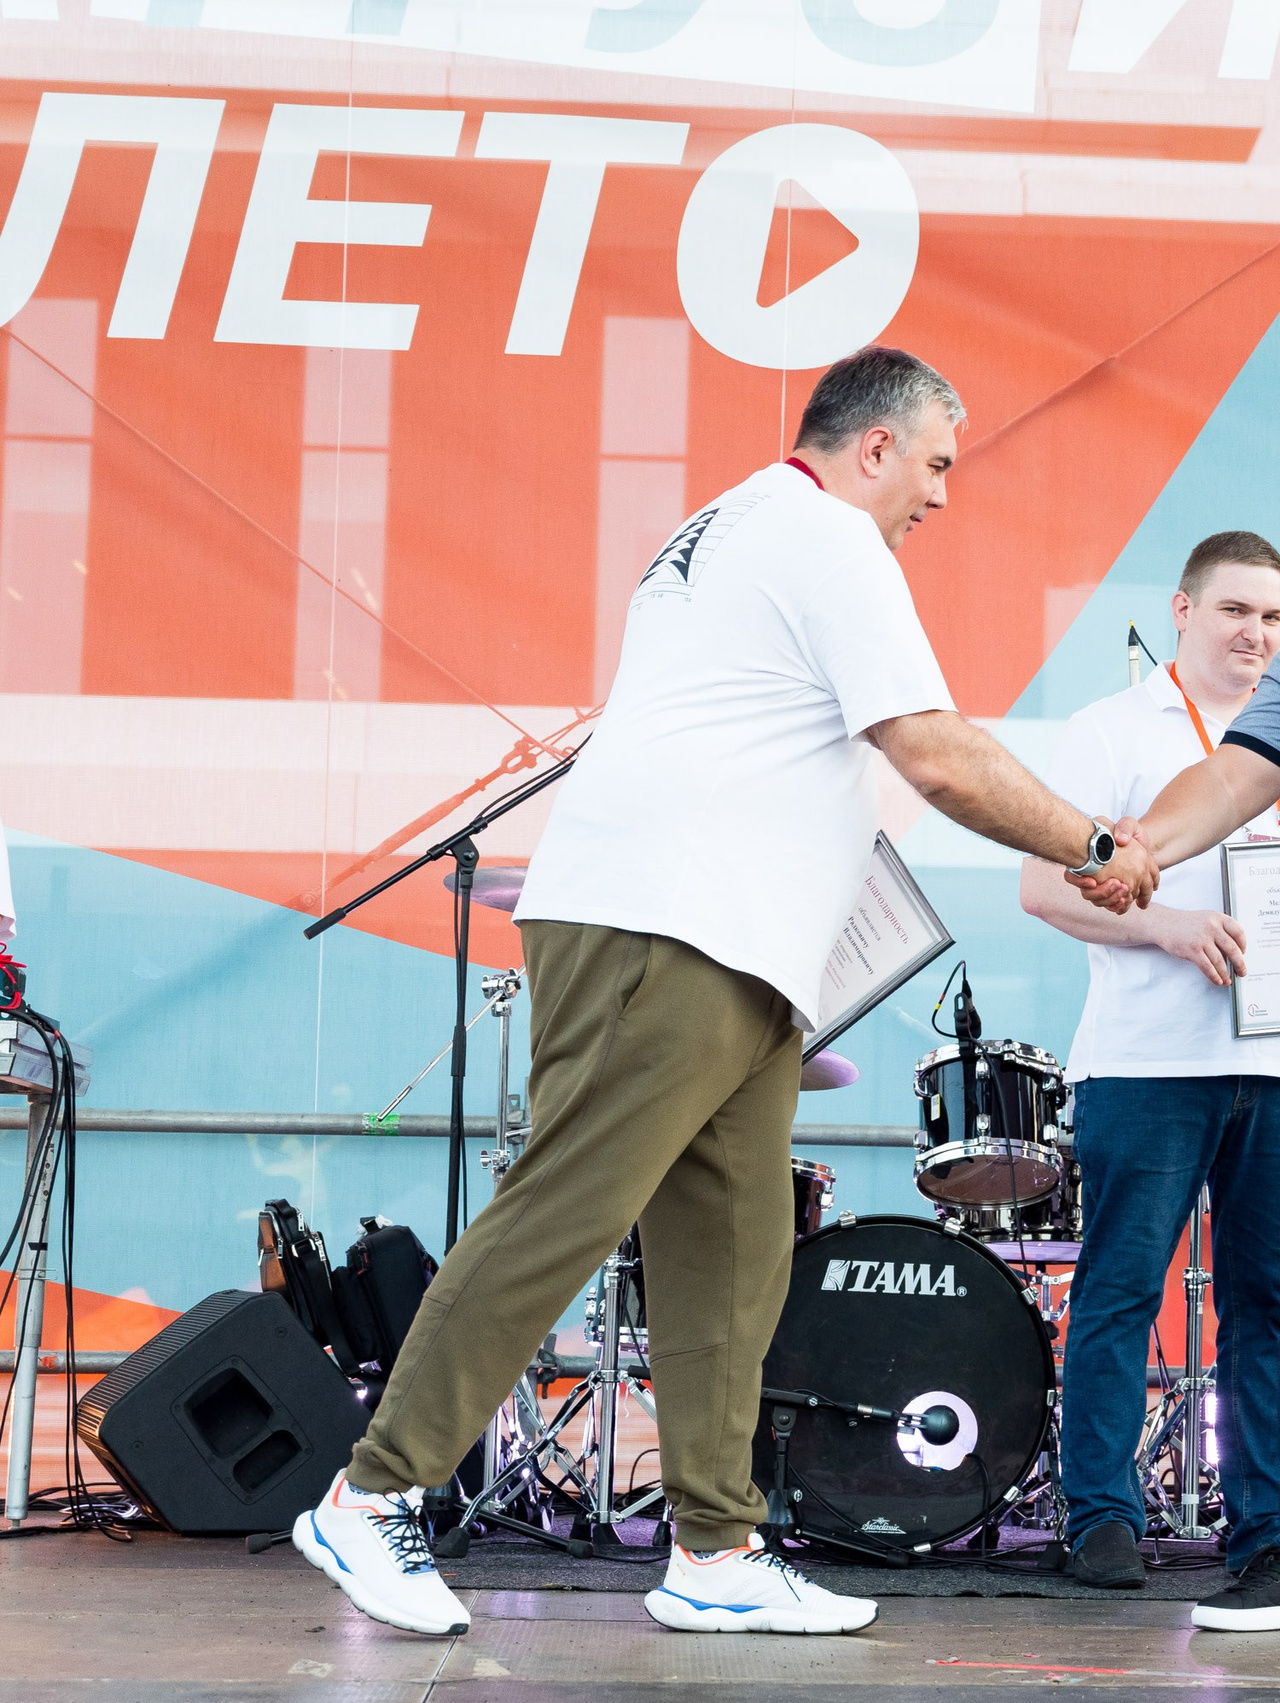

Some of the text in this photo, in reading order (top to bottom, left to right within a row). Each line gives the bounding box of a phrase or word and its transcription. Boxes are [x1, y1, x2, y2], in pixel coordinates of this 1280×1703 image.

[0, 92, 920, 370] ЛЕТО
[858, 907, 882, 942] объявляется
[864, 875, 908, 945] Благодарность
[843, 927, 874, 976] Владимировичу
[847, 916, 869, 949] Радкевичу
[847, 1260, 956, 1296] TAMA
